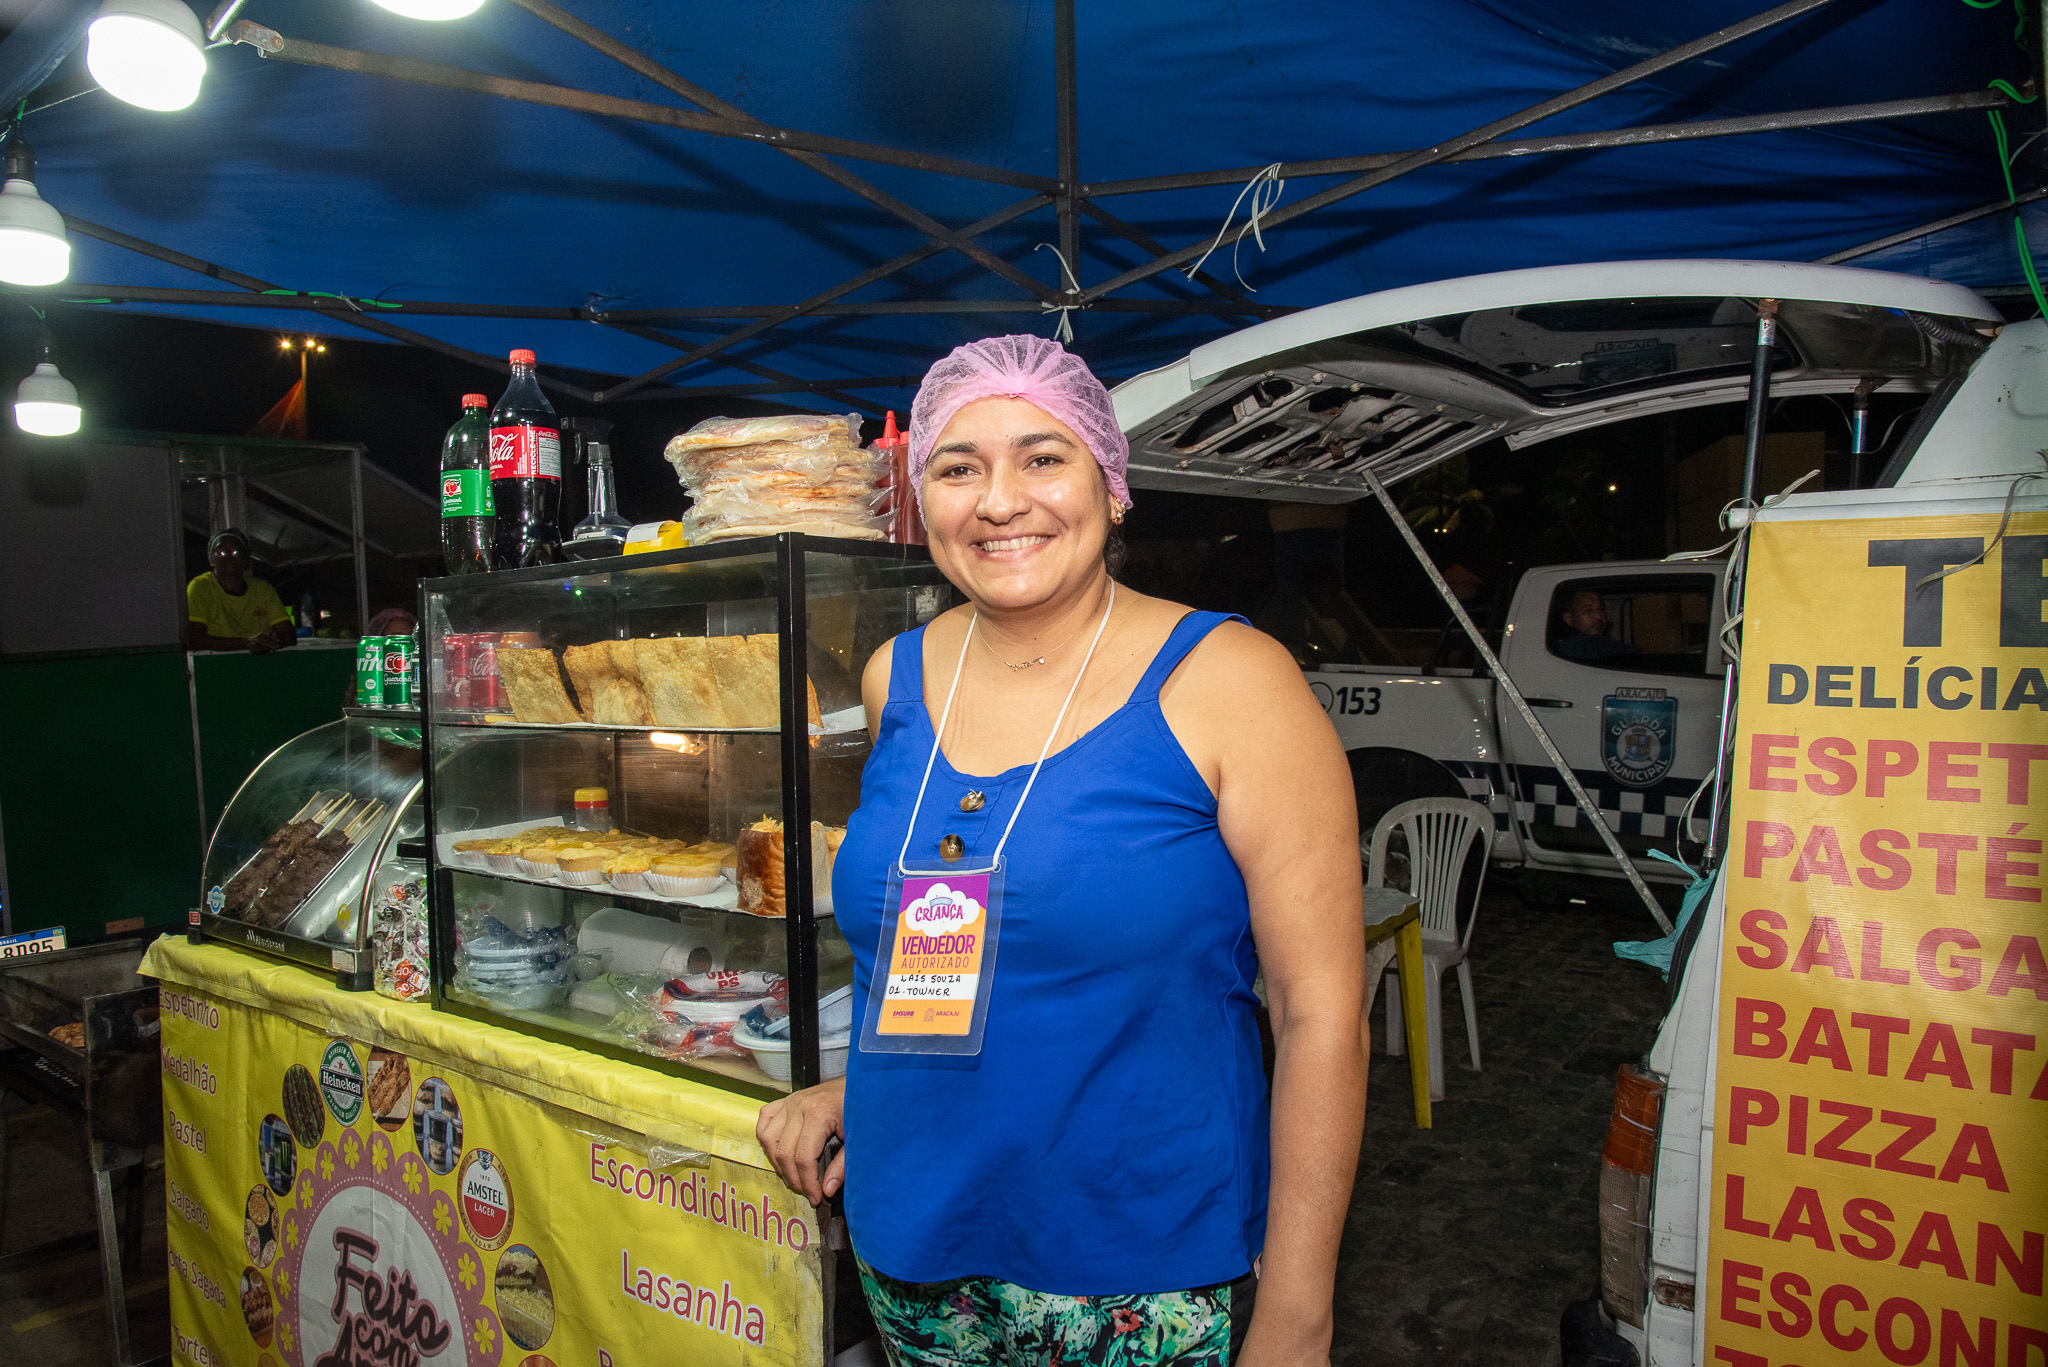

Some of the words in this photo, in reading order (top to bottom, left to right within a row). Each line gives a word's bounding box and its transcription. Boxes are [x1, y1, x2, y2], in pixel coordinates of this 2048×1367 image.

[384, 673, 411, 685] Guaraná
[1335, 686, 1382, 716] 153
[1617, 689, 1664, 699] ARACAJU
[1767, 656, 2048, 711] DELÍCIA
[1611, 715, 1667, 738] GUARDA
[1607, 756, 1668, 781] MUNICIPAL
[1749, 734, 2048, 806] ESPET
[1743, 820, 2043, 903] PASTÉ
[915, 903, 964, 922] CRIANÇA
[901, 956, 970, 969] AUTORIZADO
[902, 934, 975, 955] VENDEDOR
[1735, 909, 2048, 1001] SALGA
[931, 975, 961, 984] SOUZA
[161, 1044, 217, 1095] Medalhão
[322, 1071, 361, 1094] Heineken
[169, 1110, 206, 1154] Pastel
[1728, 1085, 2010, 1193] PIZZA
[170, 1181, 209, 1231] Salgado
[467, 1180, 503, 1206] AMSTEL
[474, 1202, 495, 1218] LAGER
[590, 1142, 810, 1251] Escondidinho
[1723, 1173, 2045, 1297] LASAN
[191, 1262, 226, 1308] Sagada
[331, 1230, 451, 1352] Feito
[622, 1250, 765, 1347] Lasanha
